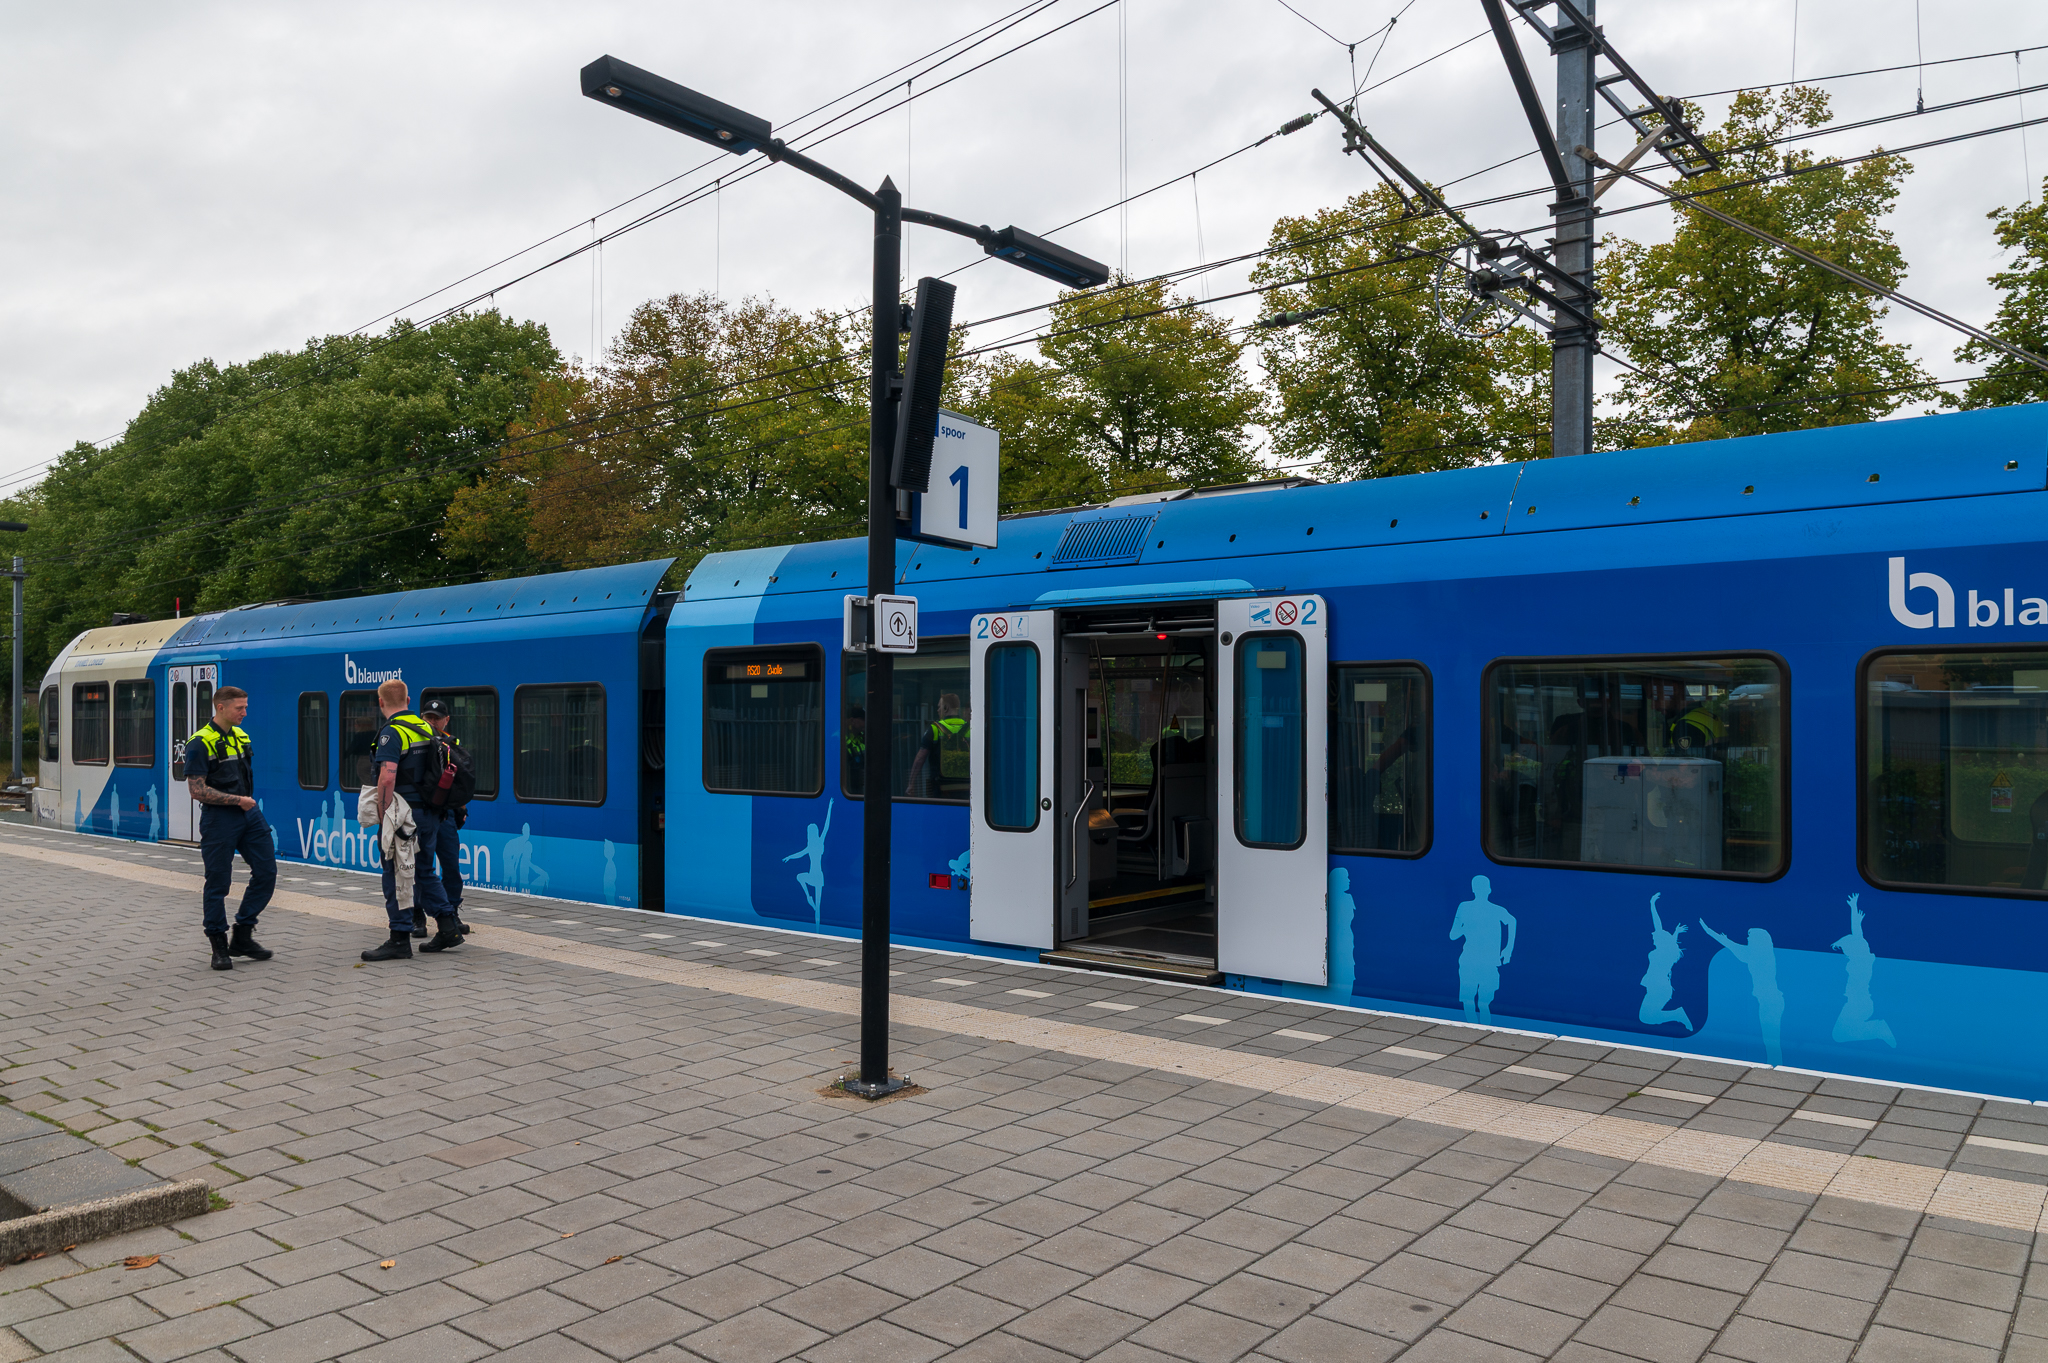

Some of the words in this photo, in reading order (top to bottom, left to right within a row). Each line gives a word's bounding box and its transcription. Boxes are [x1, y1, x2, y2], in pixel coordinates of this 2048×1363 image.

[941, 425, 966, 440] spoor
[949, 465, 969, 530] 1
[1301, 599, 1317, 625] 2
[1968, 587, 2048, 628] bla
[977, 617, 989, 639] 2
[211, 667, 216, 680] 2
[358, 667, 403, 684] blauwnet
[747, 664, 761, 676] RS20
[767, 664, 783, 676] Zwolle
